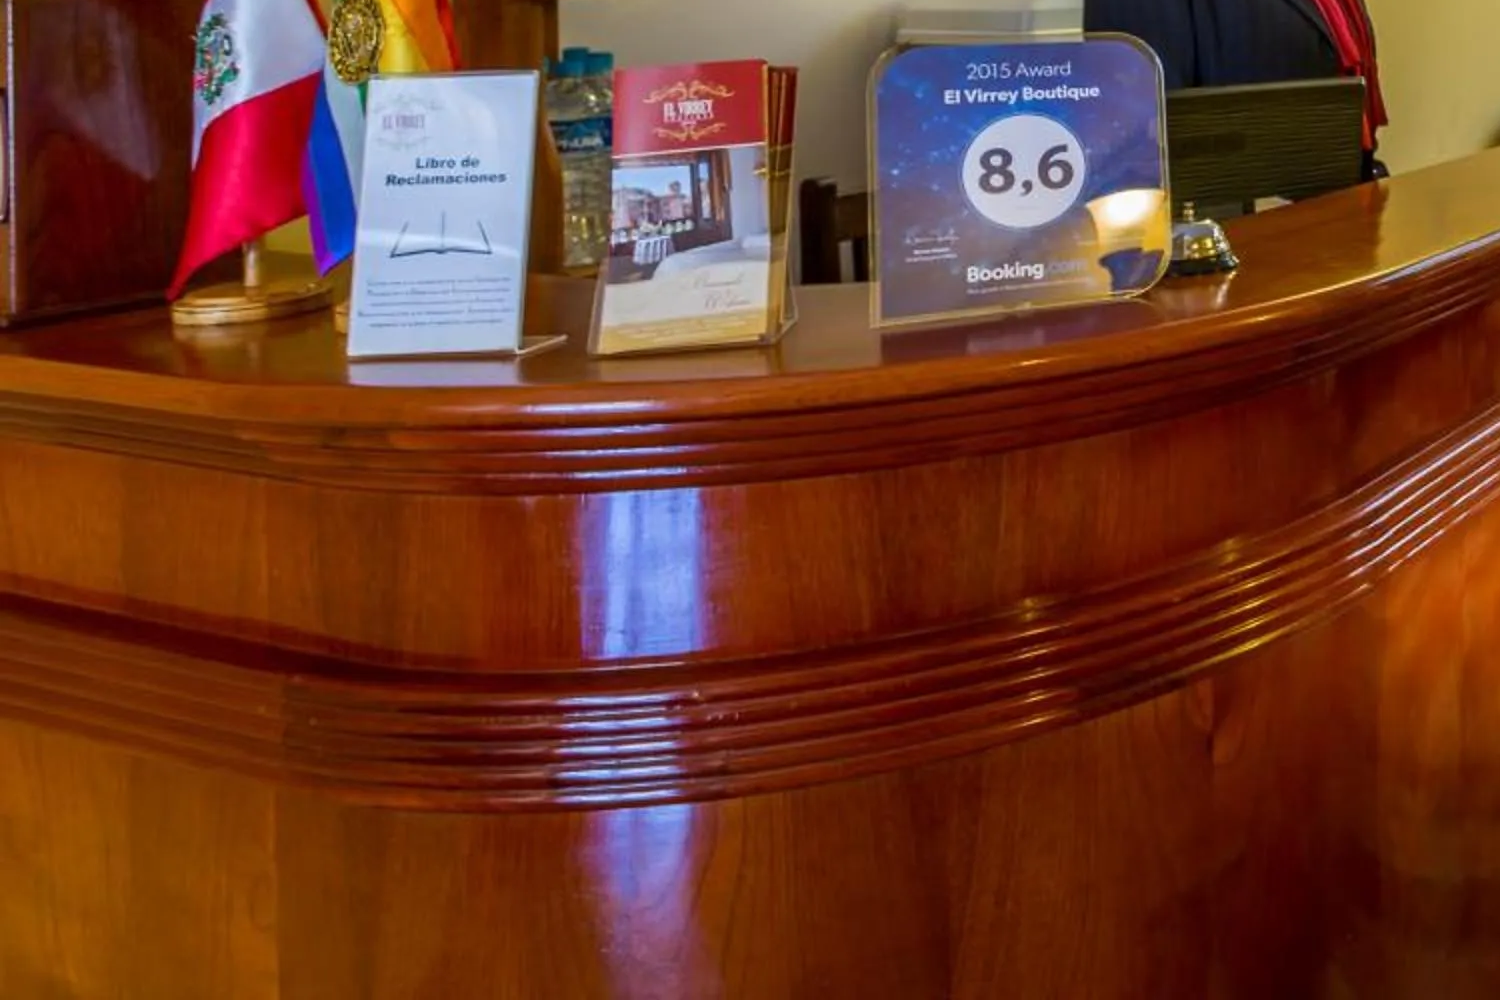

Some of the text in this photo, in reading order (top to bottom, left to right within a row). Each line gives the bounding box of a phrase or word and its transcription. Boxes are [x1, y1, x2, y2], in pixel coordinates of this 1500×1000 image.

[966, 60, 1072, 80] 2015 Award
[944, 83, 1101, 105] El Virrey Boutique
[415, 154, 481, 169] Libro de
[978, 143, 1075, 197] 8,6
[385, 171, 508, 187] Reclamaciones
